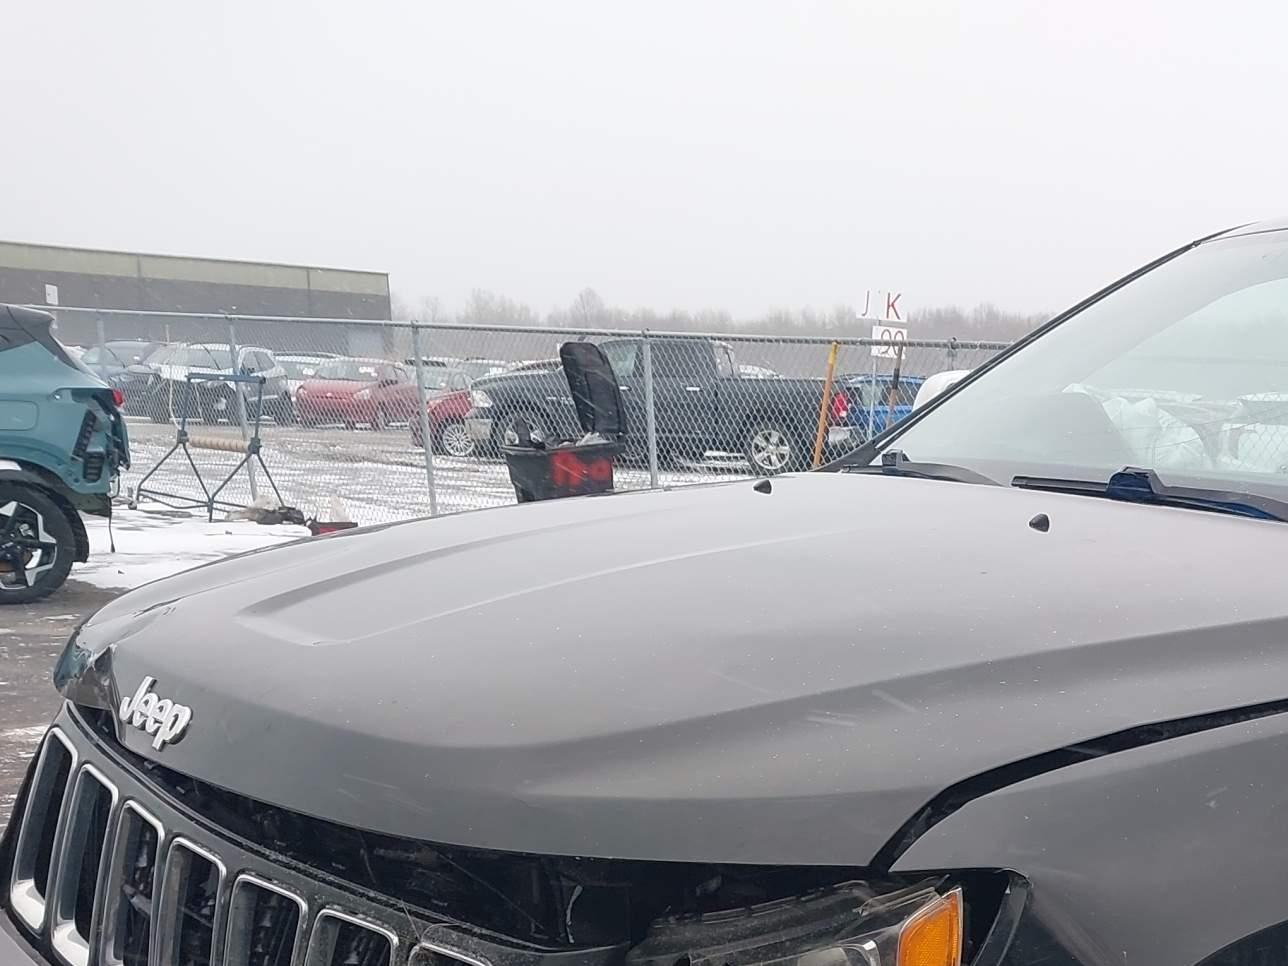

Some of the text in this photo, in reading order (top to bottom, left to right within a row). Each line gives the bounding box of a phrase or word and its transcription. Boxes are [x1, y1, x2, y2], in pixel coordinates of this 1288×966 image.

[861, 290, 902, 321] J K
[119, 675, 193, 752] Jeep
